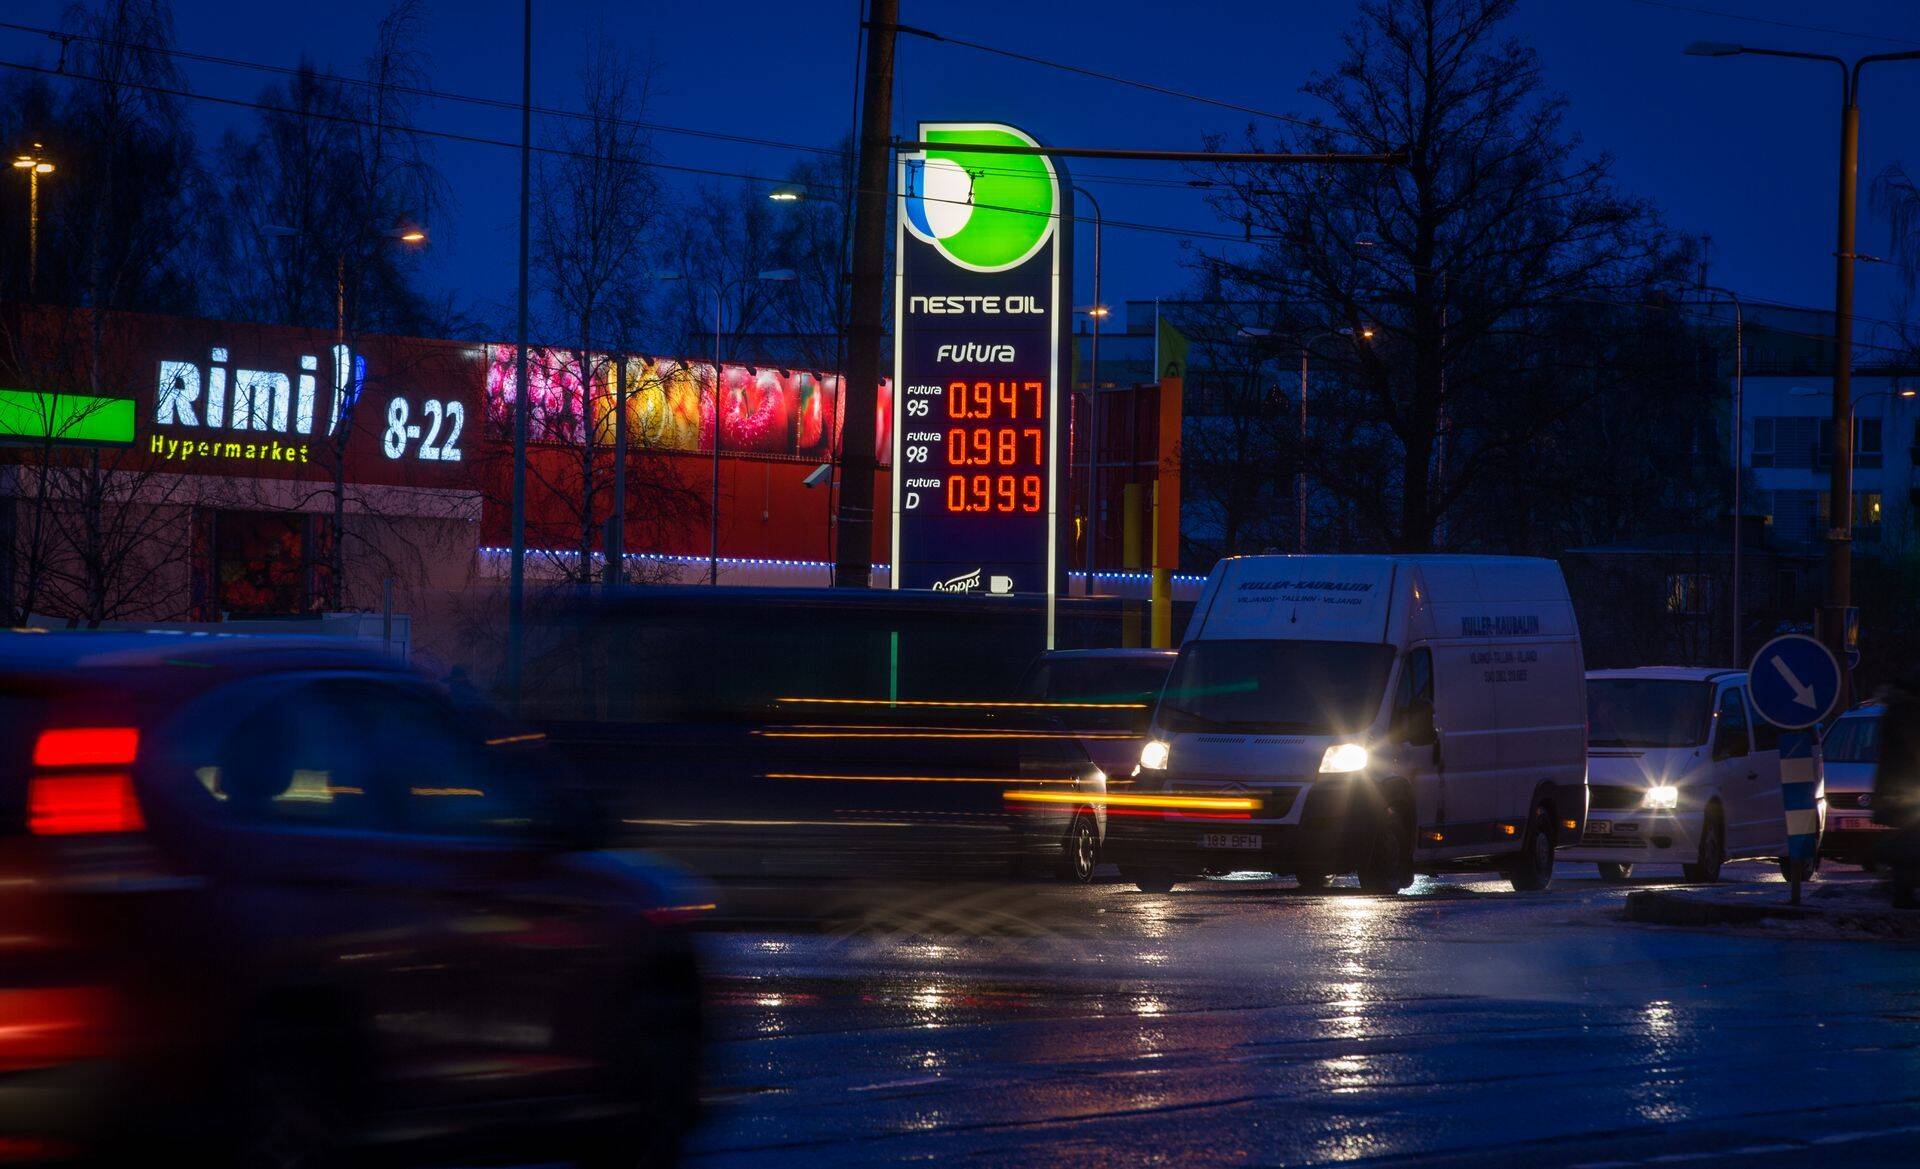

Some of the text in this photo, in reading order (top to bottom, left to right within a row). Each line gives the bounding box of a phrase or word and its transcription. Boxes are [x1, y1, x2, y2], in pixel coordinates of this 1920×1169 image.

[909, 296, 1044, 314] NESTE OIL
[936, 342, 1016, 363] Futura
[156, 347, 318, 434] Rimi
[906, 382, 1042, 419] 95 0.947
[907, 384, 942, 395] Futura
[384, 396, 465, 461] 8-22
[906, 431, 941, 442] Futura
[151, 434, 309, 463] Hypermarket
[906, 428, 1041, 466] 98 0.987
[905, 477, 941, 489] Futura
[905, 475, 1041, 513] D 0.999
